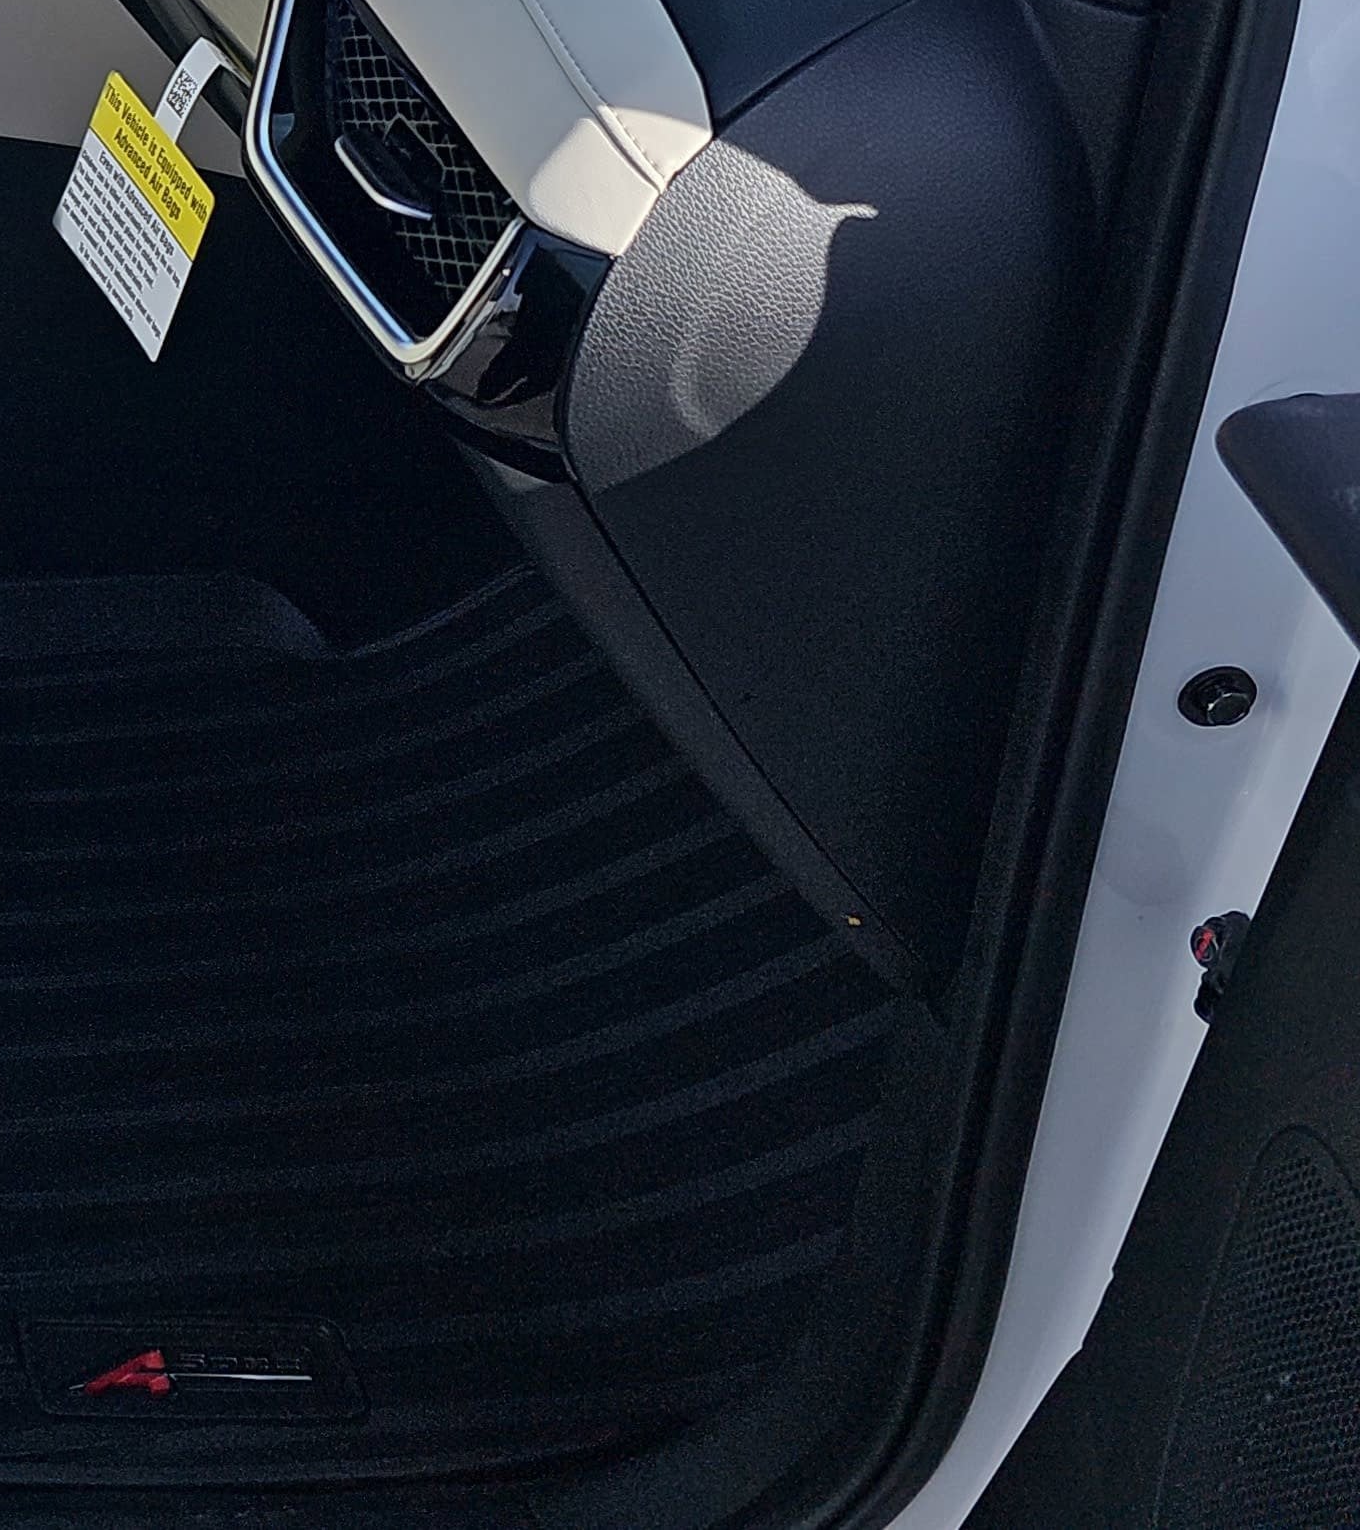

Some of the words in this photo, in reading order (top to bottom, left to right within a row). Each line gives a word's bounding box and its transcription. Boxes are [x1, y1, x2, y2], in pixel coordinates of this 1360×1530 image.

[99, 150, 113, 174] Even
[124, 184, 152, 224] Advanced
[150, 219, 160, 235] Air
[159, 230, 174, 255] Bags
[104, 82, 121, 112] This
[121, 102, 148, 145] Vehicle
[147, 136, 157, 156] is
[156, 147, 192, 200] Equipped
[190, 194, 207, 223] with
[114, 127, 151, 178] Advanced
[148, 171, 162, 194] Air
[161, 186, 180, 220] Bags
